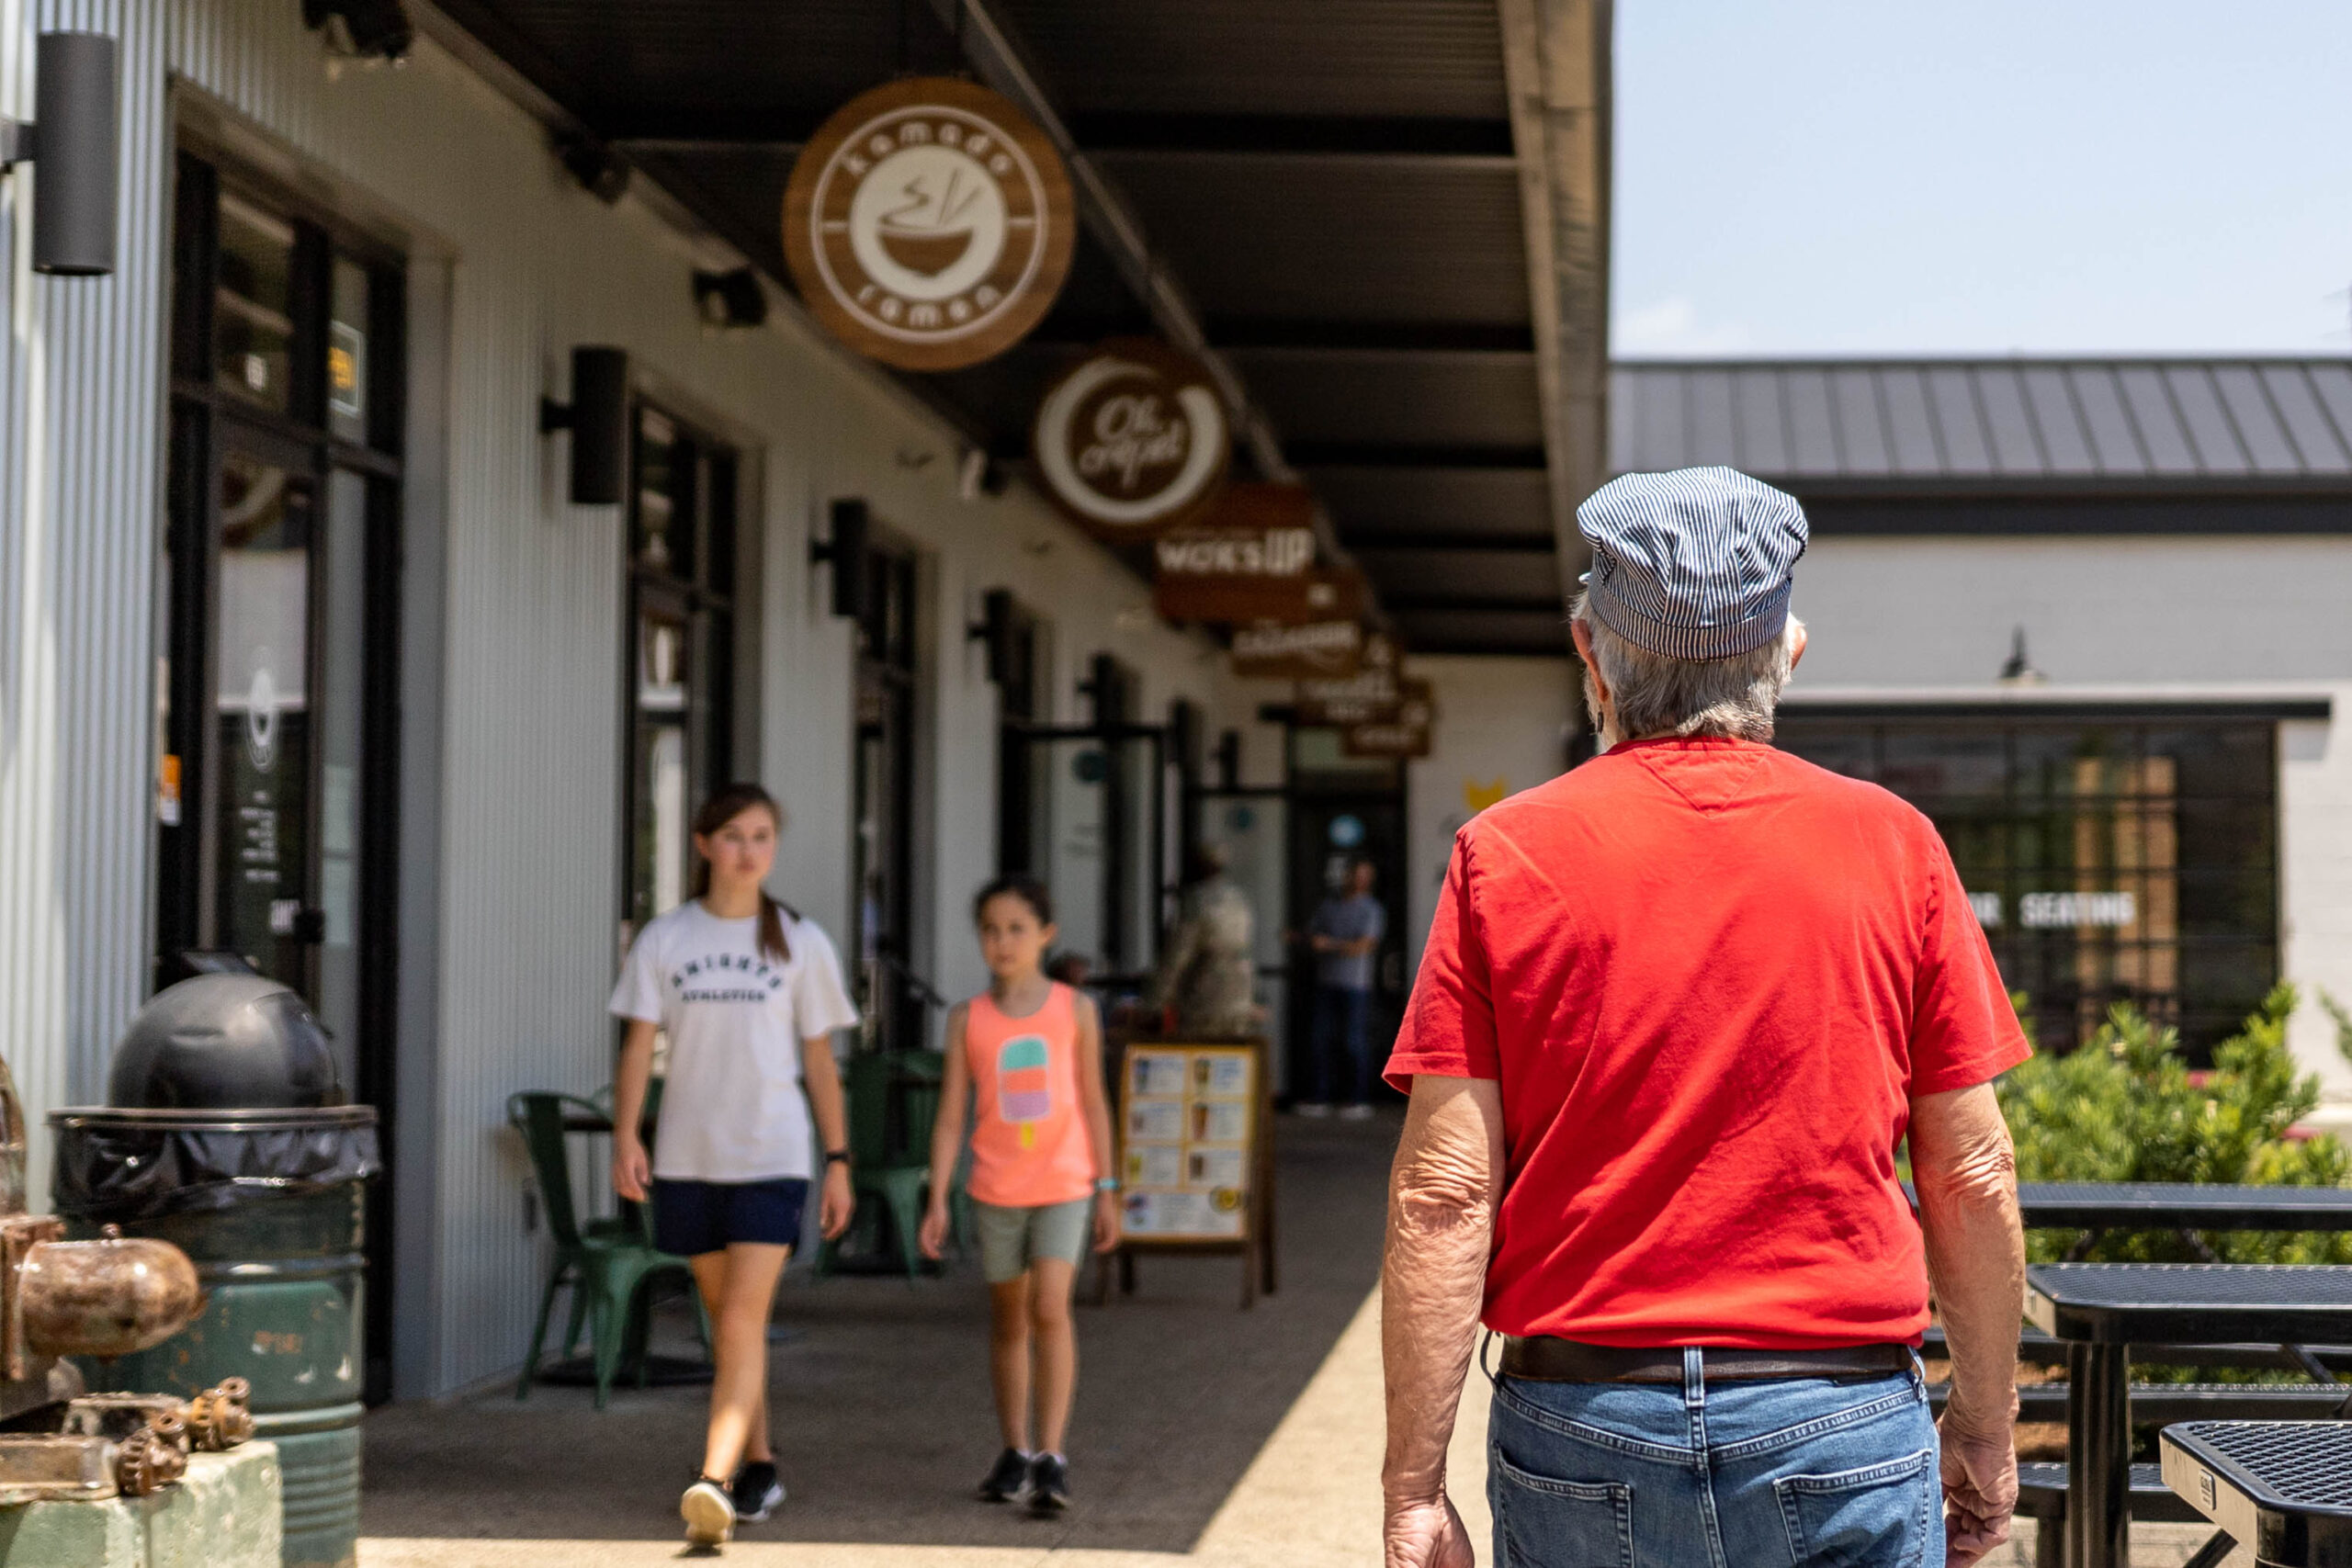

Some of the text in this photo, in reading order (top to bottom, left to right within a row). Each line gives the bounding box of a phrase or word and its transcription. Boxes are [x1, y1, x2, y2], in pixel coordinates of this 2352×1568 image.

[840, 121, 1012, 177] kamado
[857, 285, 1001, 327] ramen
[2020, 891, 2136, 928] SEATING
[681, 988, 766, 1002] ATHLETICS
